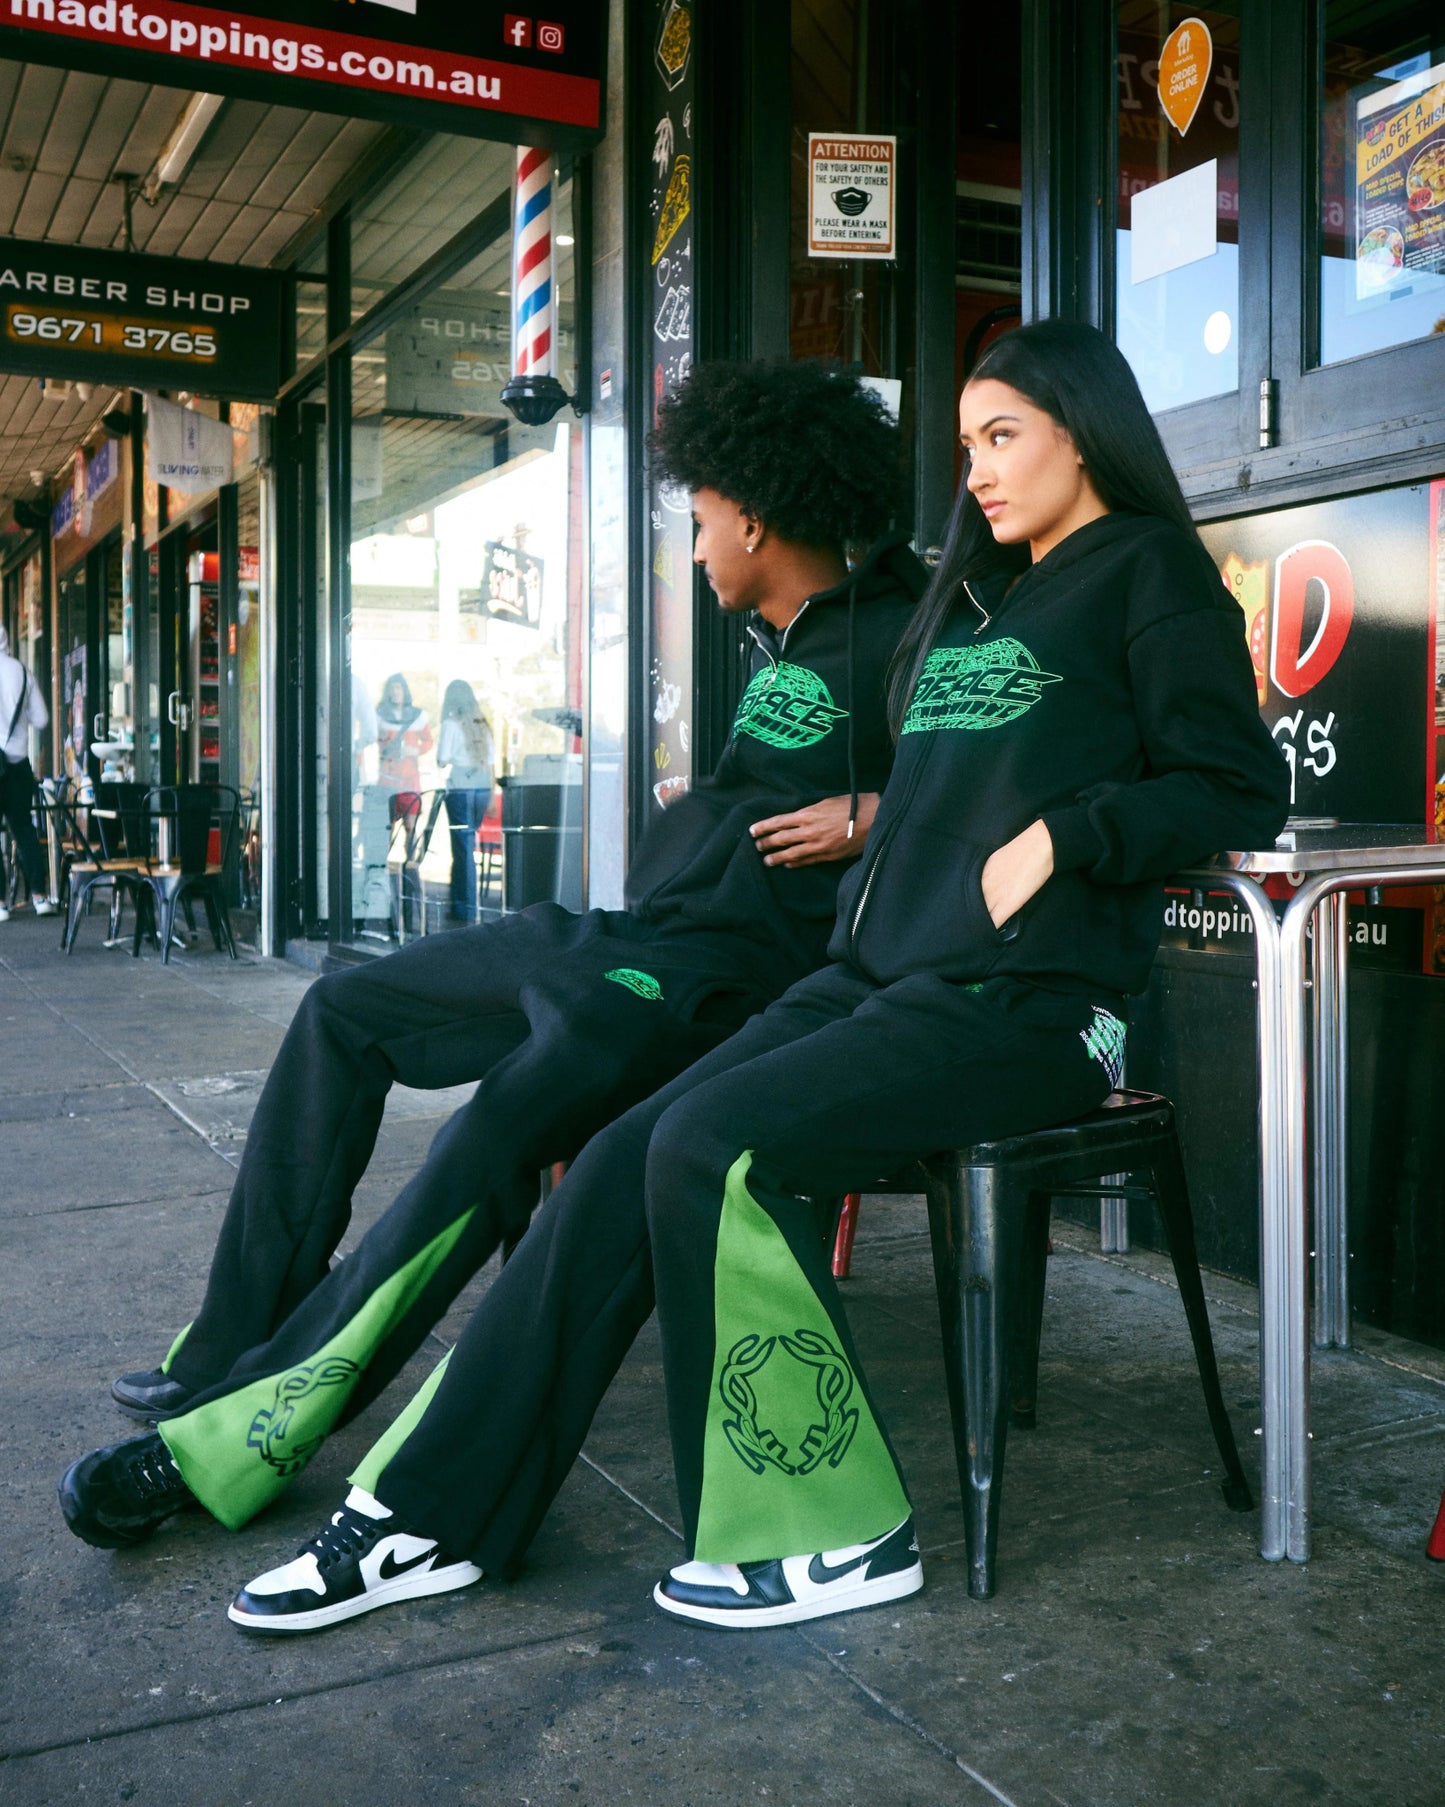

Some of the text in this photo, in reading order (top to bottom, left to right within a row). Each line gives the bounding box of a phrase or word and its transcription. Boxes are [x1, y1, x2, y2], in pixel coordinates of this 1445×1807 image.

[11, 0, 501, 100] madtoppings.com.au
[1168, 74, 1199, 96] ONLINE
[1170, 63, 1197, 85] ORDER
[1389, 103, 1423, 137] GET A
[1366, 102, 1445, 172] LOAD OF THIS!
[815, 142, 890, 159] ATTENTION
[816, 162, 889, 174] FOR YOUR SAFETY AND
[815, 174, 889, 186] THE SAFETY OF OTHERS
[814, 217, 888, 229] PLEASE WEAR A MASK
[821, 228, 882, 240] BEFORE ENTERING
[0, 268, 250, 315] ARBER SHOP
[13, 312, 217, 356] 9671 3765
